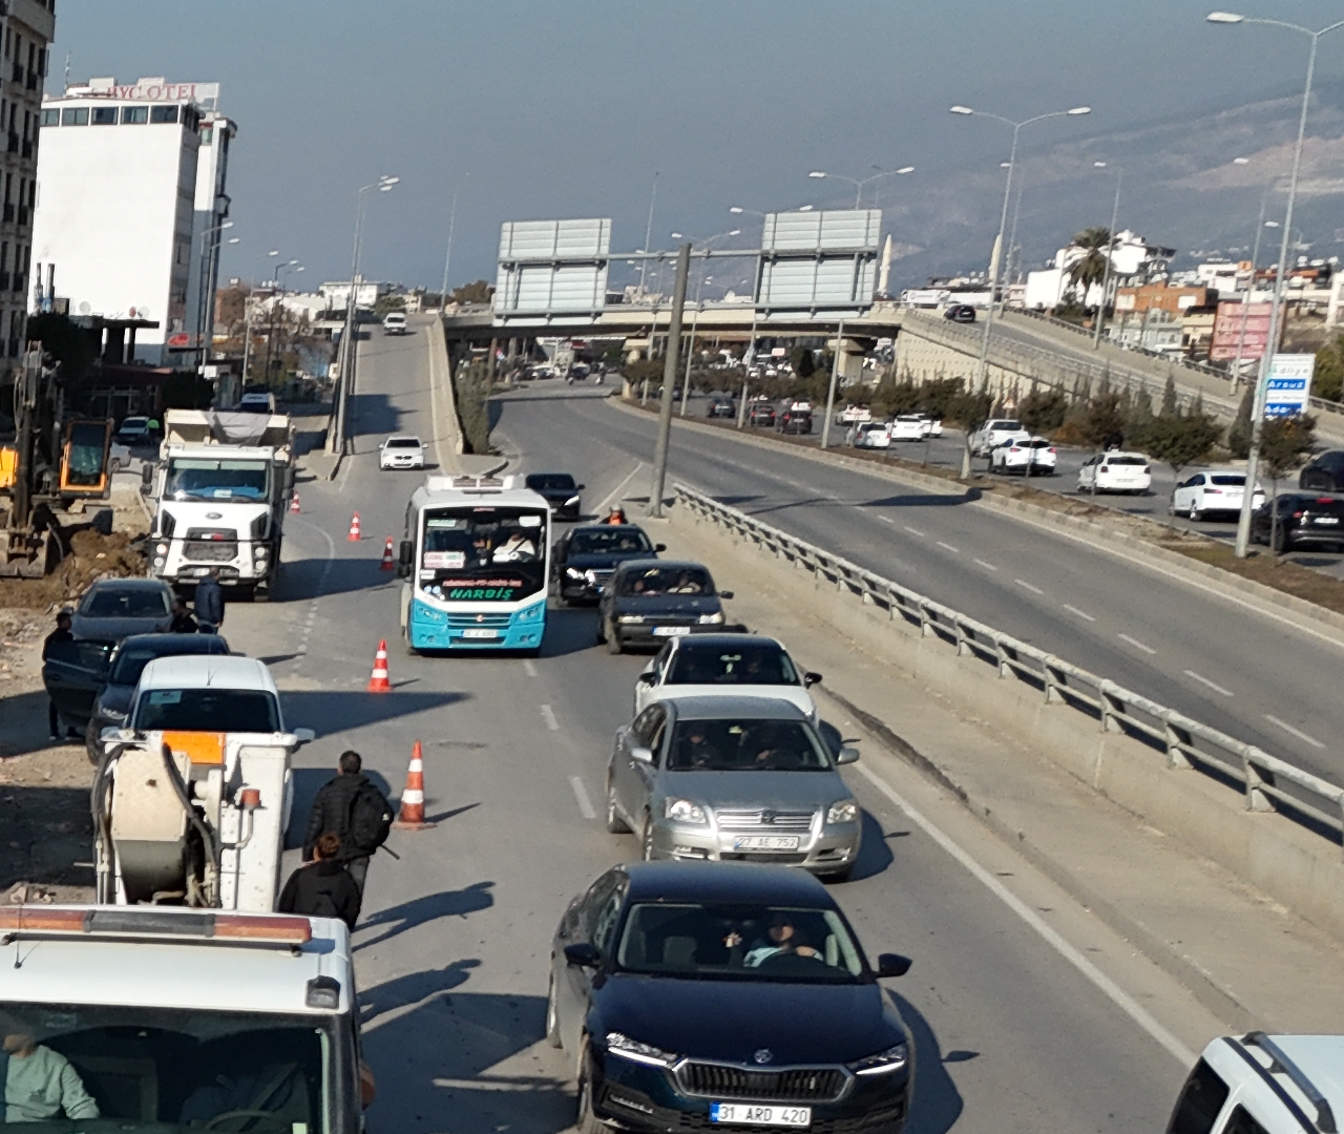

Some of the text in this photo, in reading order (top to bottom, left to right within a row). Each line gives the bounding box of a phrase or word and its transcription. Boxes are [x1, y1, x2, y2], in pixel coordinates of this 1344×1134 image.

[740, 838, 752, 846] 27
[720, 1106, 808, 1124] 31 ARD 420
